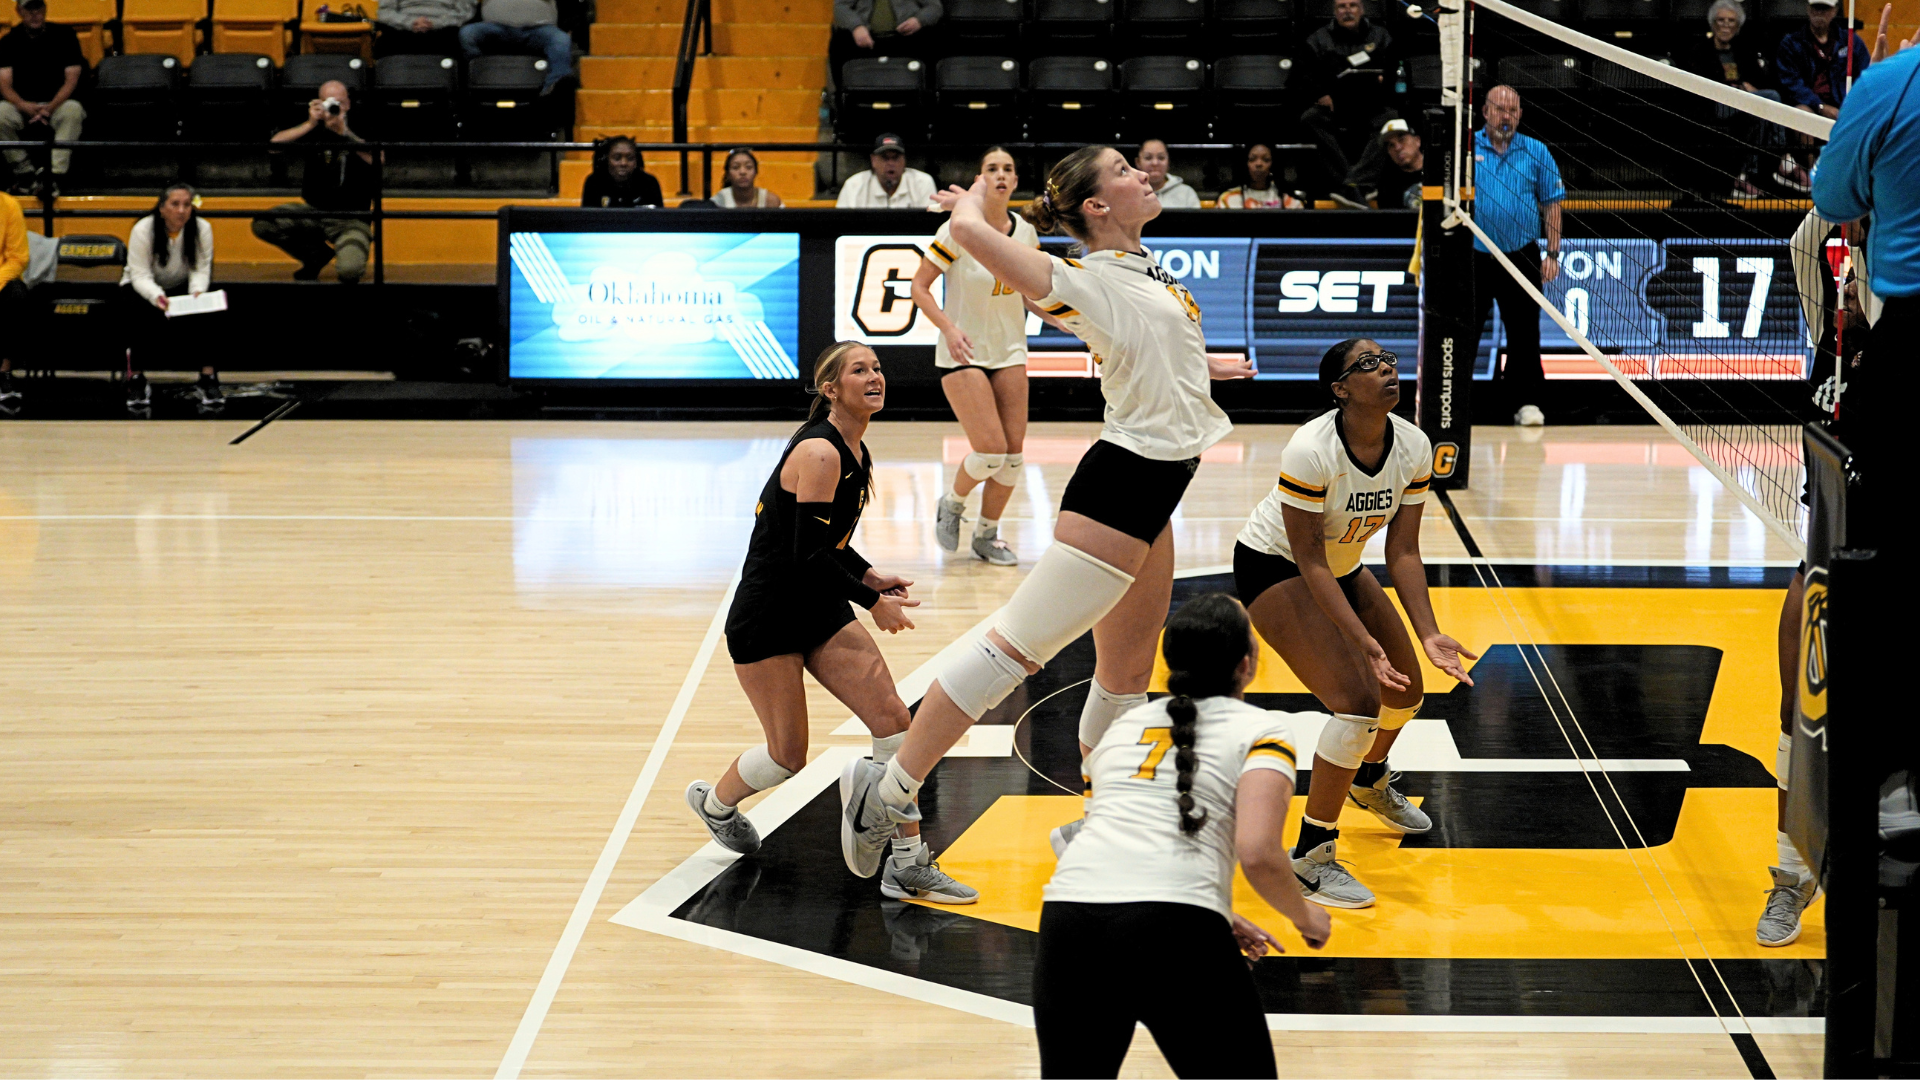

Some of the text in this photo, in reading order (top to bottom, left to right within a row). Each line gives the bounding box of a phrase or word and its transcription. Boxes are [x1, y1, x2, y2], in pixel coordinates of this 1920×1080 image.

[588, 281, 722, 305] Oklahoma
[1278, 270, 1406, 313] SET
[1692, 257, 1775, 339] 17
[578, 314, 602, 324] OIL
[626, 314, 696, 324] NATURAL
[703, 314, 734, 324] GAS
[1565, 287, 1589, 340] 0
[1439, 337, 1454, 429] sports imports
[1345, 488, 1393, 512] AGGIES
[1338, 514, 1386, 543] 17
[1128, 726, 1175, 781] 7
